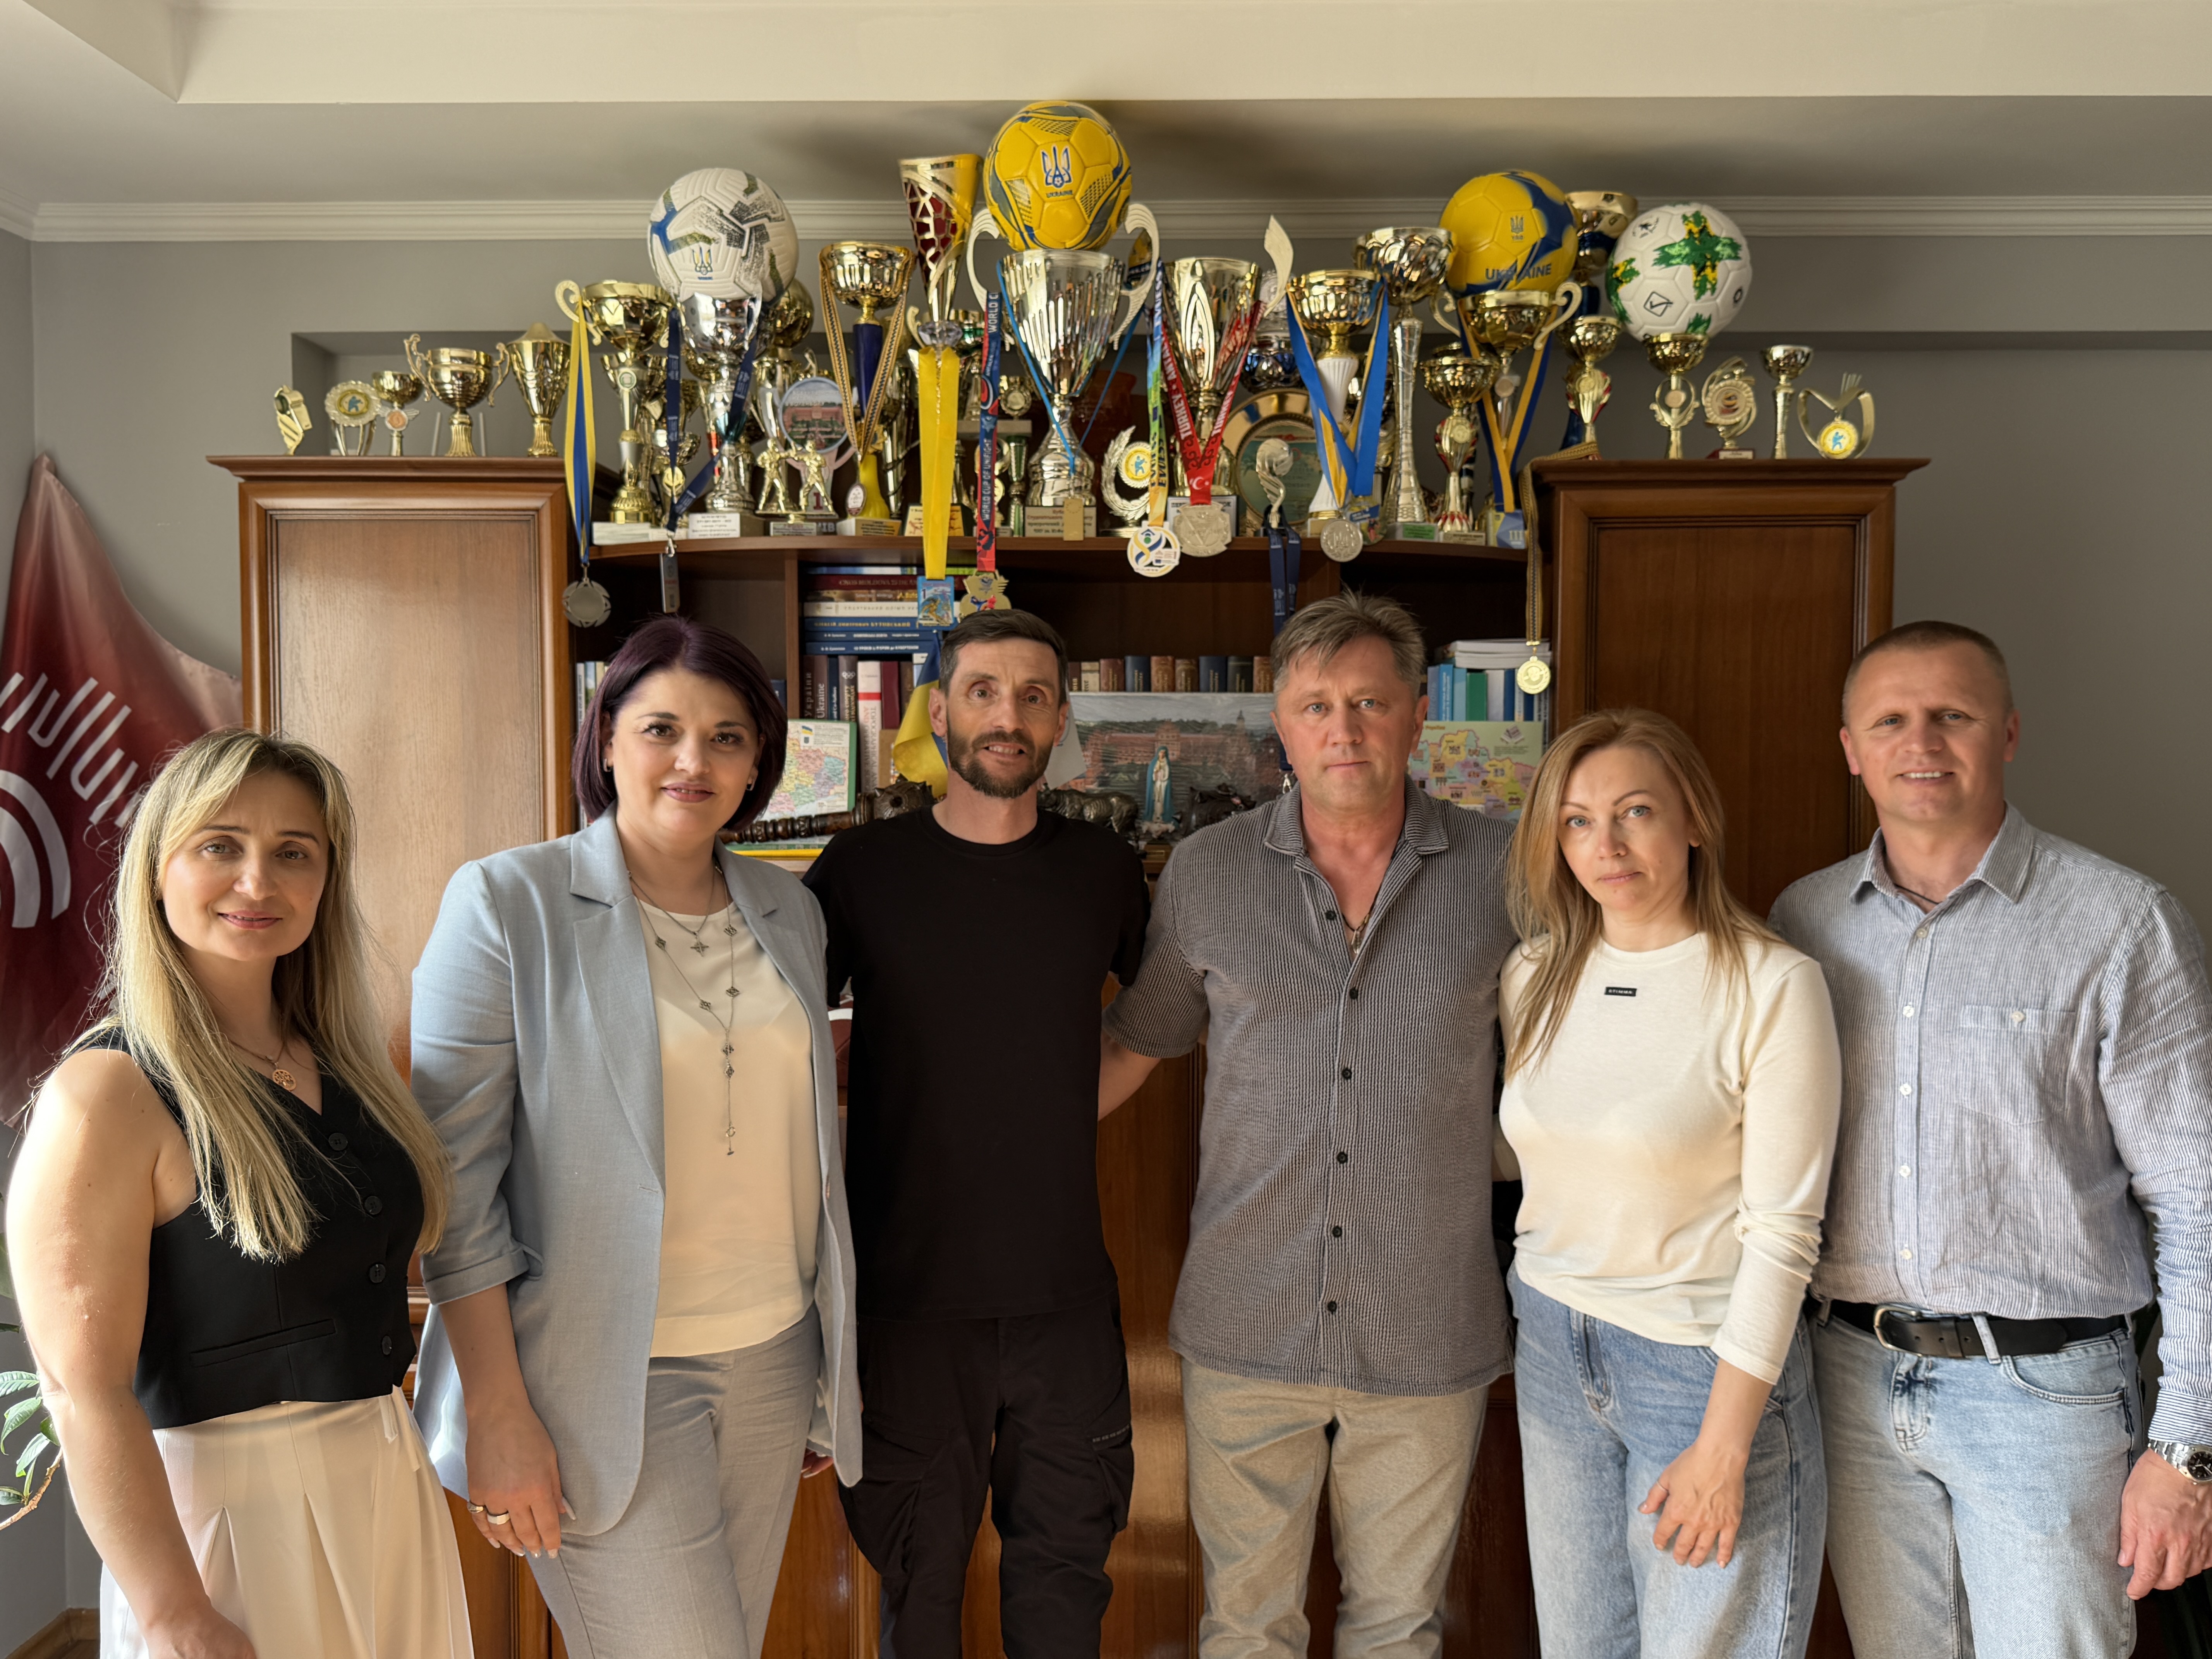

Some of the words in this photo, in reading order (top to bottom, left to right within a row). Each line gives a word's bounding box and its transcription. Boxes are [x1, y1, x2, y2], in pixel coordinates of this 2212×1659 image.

[1486, 263, 1551, 280] UKRAINE
[988, 302, 998, 333] WORLD
[1171, 392, 1192, 440] TURKEY
[983, 438, 991, 469] UNIFIGHT
[814, 493, 823, 510] 1
[982, 481, 991, 494] CUP
[982, 496, 991, 520] WORLD
[804, 672, 814, 716] України
[816, 683, 825, 718] Ukraine
